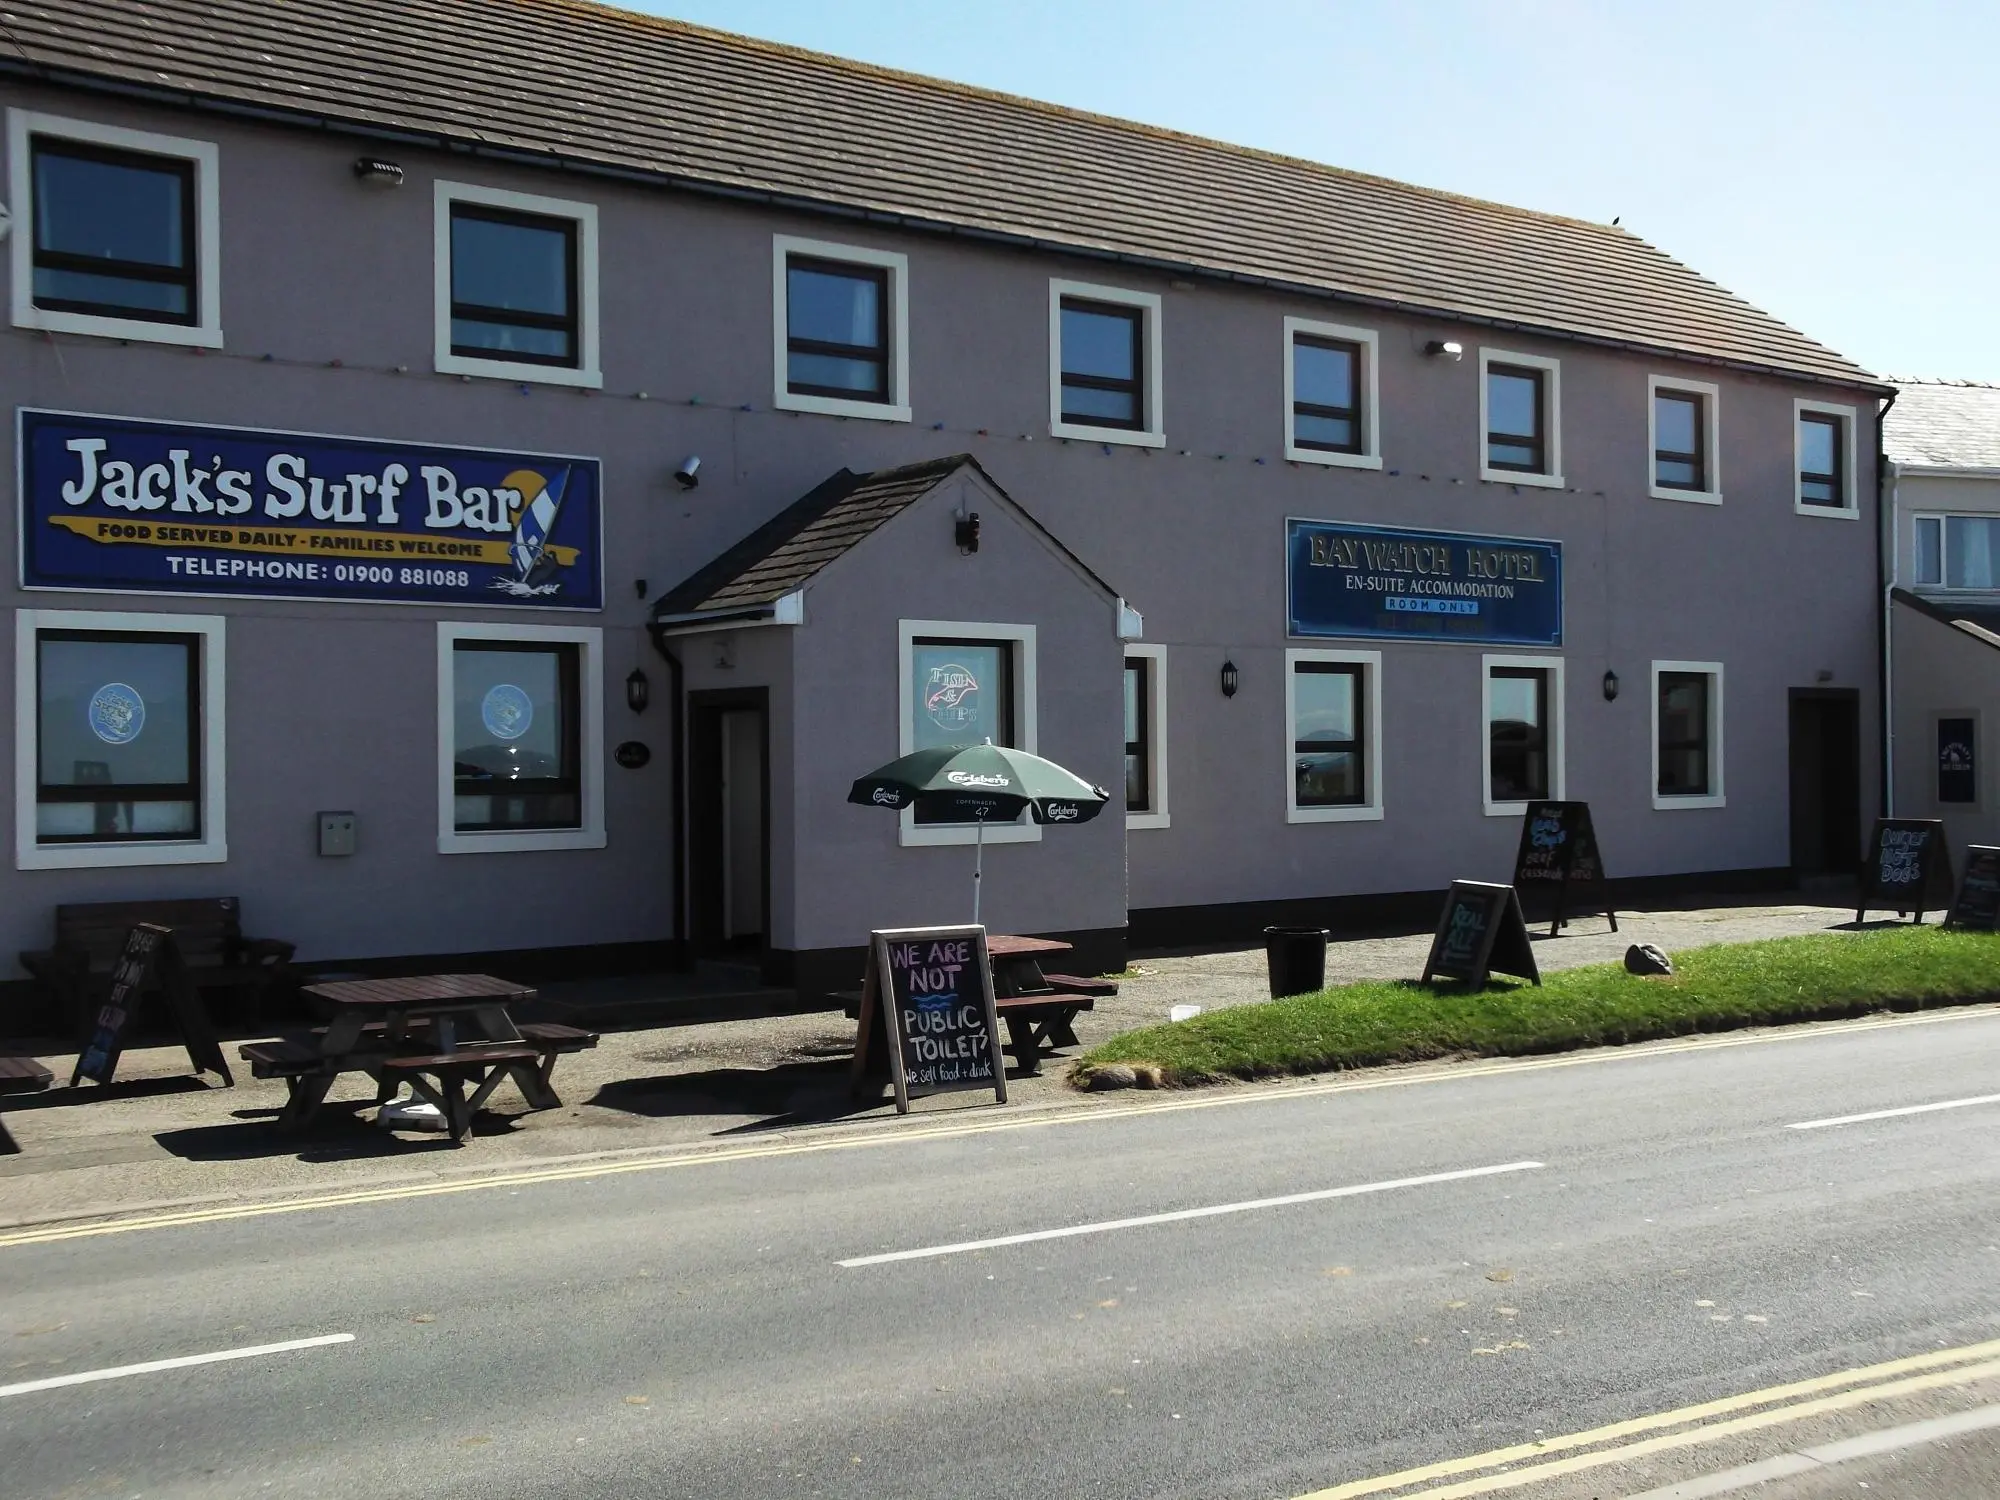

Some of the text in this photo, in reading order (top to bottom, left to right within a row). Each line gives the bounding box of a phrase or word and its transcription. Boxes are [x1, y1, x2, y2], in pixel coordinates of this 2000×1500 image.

[61, 438, 522, 532] Jack's Surf Bar
[97, 523, 152, 539] FOOD
[156, 527, 234, 544] SERVED
[238, 531, 297, 547] DAILY
[309, 535, 395, 552] FAMILIES
[399, 540, 483, 557] WELCOME
[166, 556, 470, 588] TELEPHONE: 01900 881088
[1466, 548, 1545, 583] HOTEL
[1345, 574, 1515, 600] EN-SUITE ACCOMMODATION
[1388, 599, 1477, 613] ROOM ONLY
[947, 771, 1010, 788] Carlsberg
[975, 807, 989, 817] 47
[1047, 803, 1079, 822] Carlsberg
[890, 941, 970, 969] WE ARE
[909, 964, 962, 993] NOT
[904, 1005, 981, 1034] PUBLIC
[920, 1065, 937, 1084] sell
[939, 1062, 961, 1082] food
[969, 1056, 993, 1078] drink
